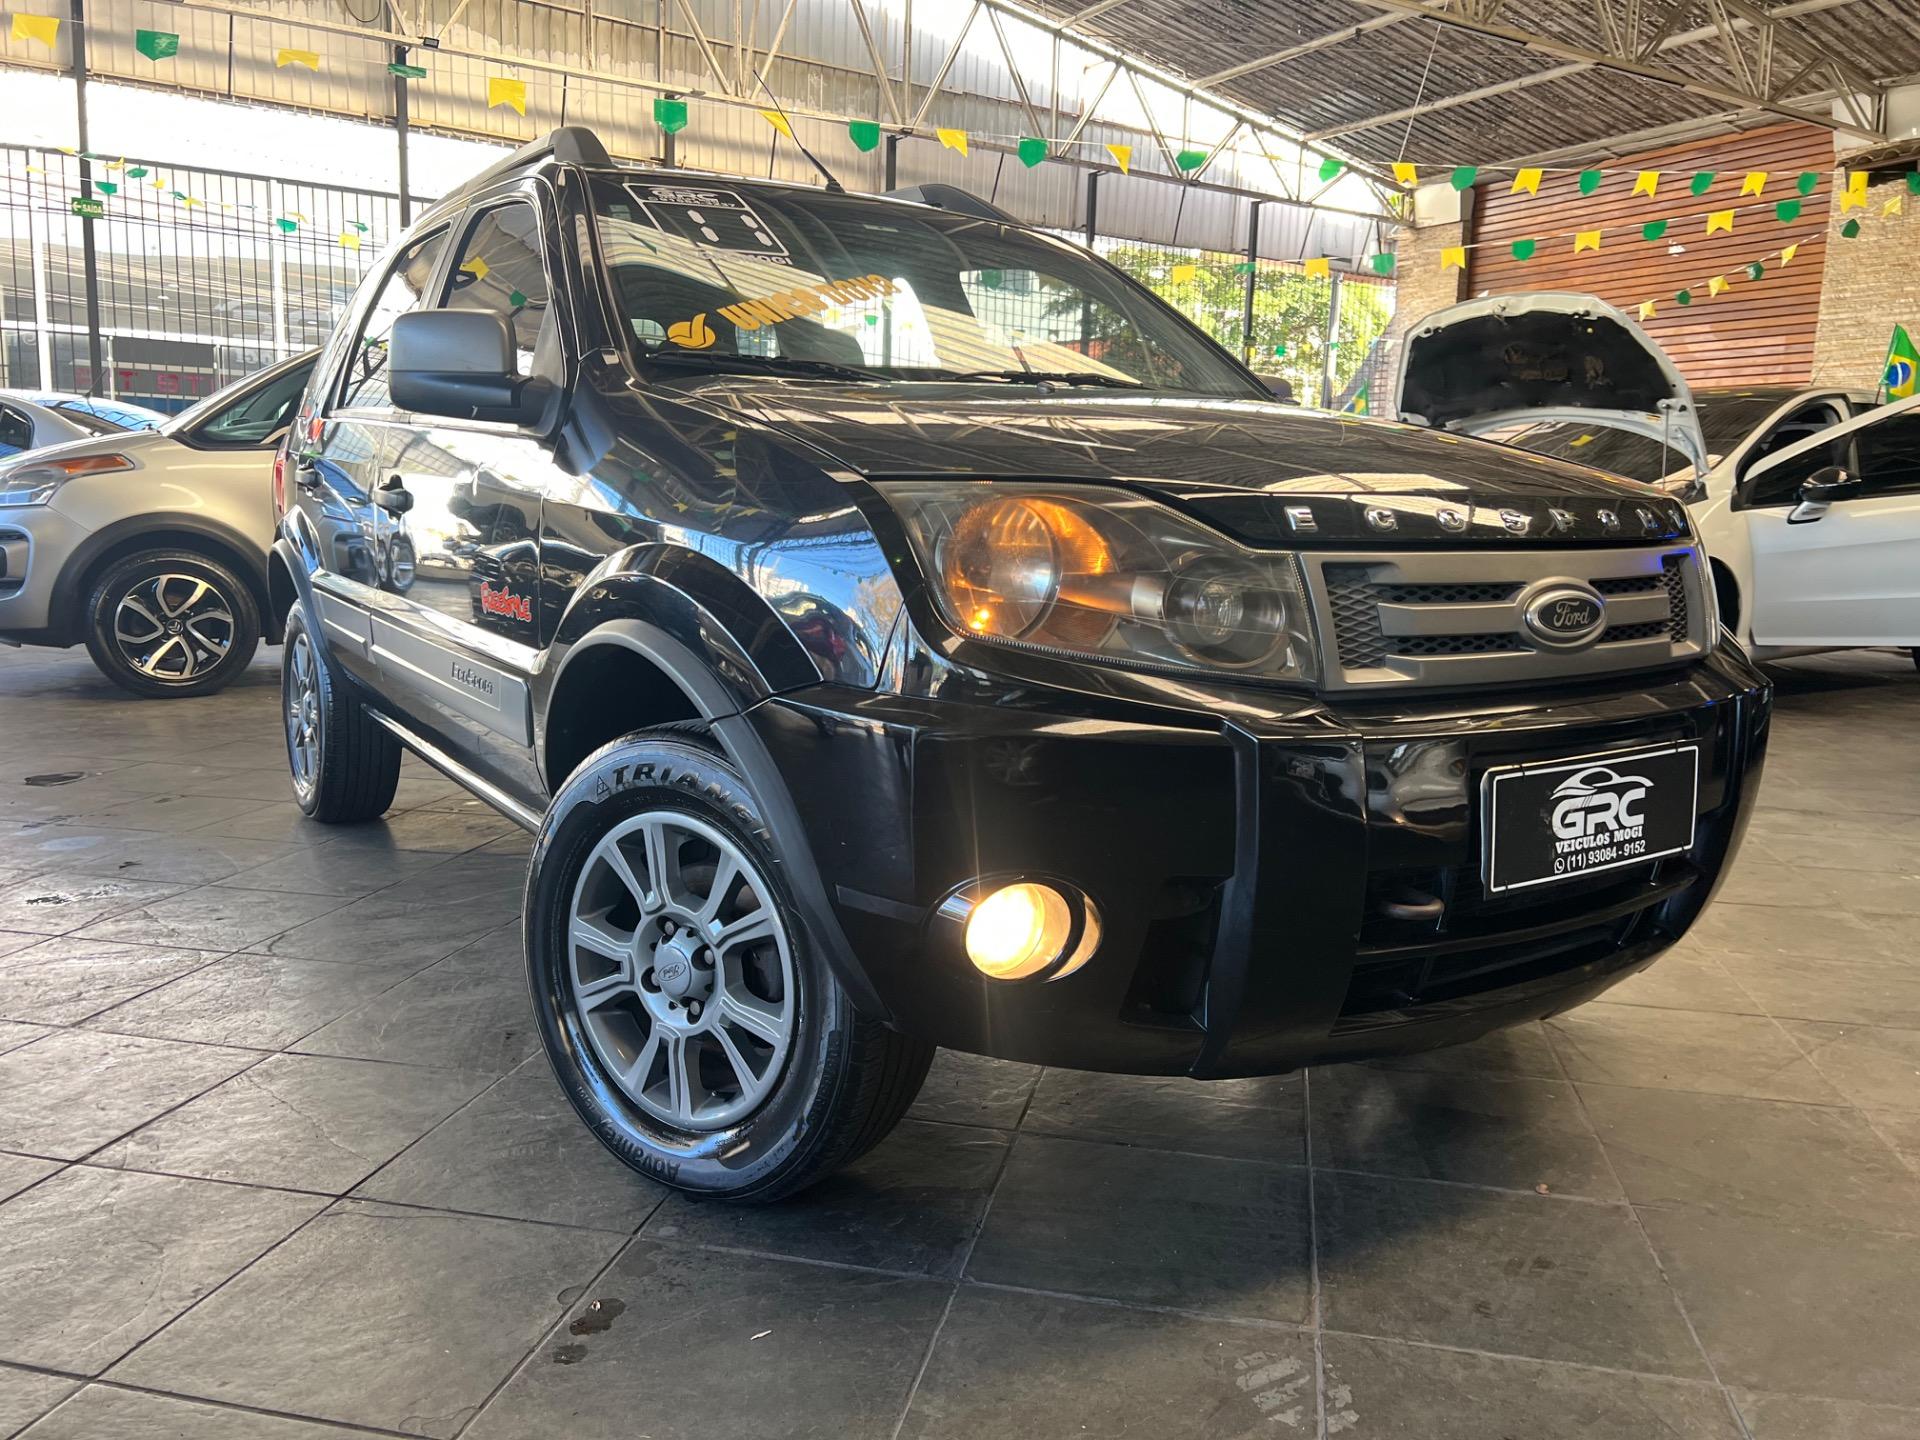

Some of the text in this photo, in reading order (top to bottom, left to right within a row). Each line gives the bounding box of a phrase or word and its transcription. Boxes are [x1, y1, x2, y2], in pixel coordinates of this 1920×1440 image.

[1553, 601, 1591, 628] Ford
[1552, 787, 1646, 839] GRC
[1555, 825, 1643, 854] VEICULOS MOGI
[1567, 853, 1586, 872] (11)
[1588, 846, 1617, 864] 93084
[1623, 840, 1646, 856] 9152
